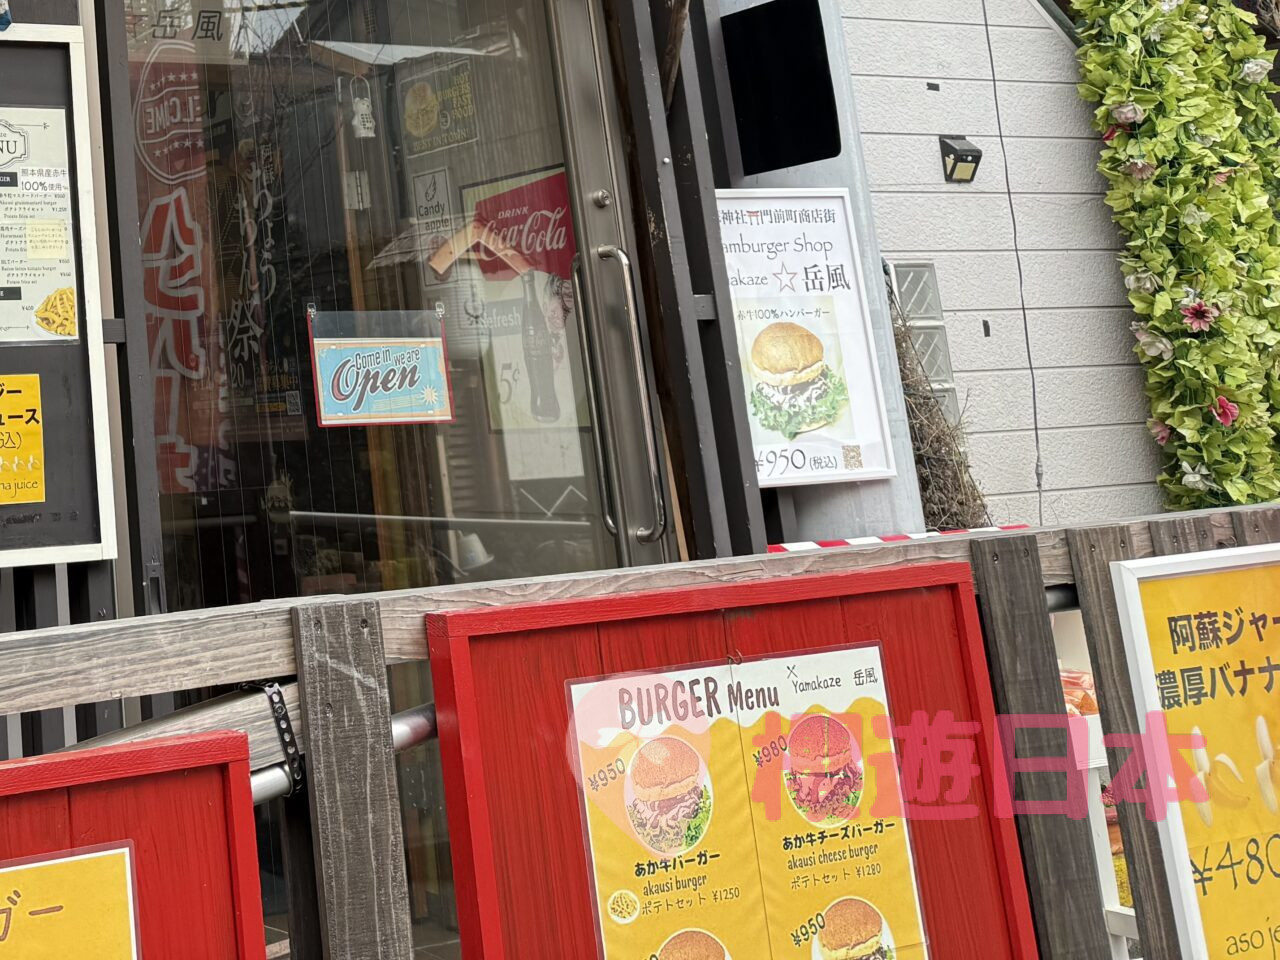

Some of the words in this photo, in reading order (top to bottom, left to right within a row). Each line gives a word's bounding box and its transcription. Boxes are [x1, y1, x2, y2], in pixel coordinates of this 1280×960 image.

[417, 202, 445, 218] Candy
[498, 206, 528, 219] DRINK
[759, 208, 837, 225] 門前町商店街
[424, 216, 450, 232] apple
[723, 233, 789, 260] amburger
[793, 232, 833, 260] Shop
[728, 273, 769, 287] akaze
[802, 264, 851, 292] 岳風
[737, 308, 830, 321] 赤牛100%ハンバーガー
[354, 352, 381, 370] Come
[382, 346, 391, 362] in
[393, 354, 406, 366] we
[406, 348, 420, 362] are
[331, 357, 421, 412] Open
[11, 479, 38, 498] juice
[1167, 606, 1280, 655] 阿蘇ジャ
[618, 676, 722, 731] BURGER
[728, 684, 780, 714] Menu
[792, 675, 842, 694] Yamakaze
[853, 667, 879, 687] 岳風
[752, 734, 788, 768] ¥980
[588, 757, 626, 792] ¥950
[782, 820, 896, 850] あか牛チーズバーガー
[634, 850, 721, 876] あか牛バーガー
[787, 851, 816, 871] akausi
[818, 848, 847, 866] cheese
[849, 843, 879, 862] burger
[643, 877, 673, 897] akausi
[675, 874, 708, 897] burger
[791, 868, 851, 890] ポテトセット
[856, 863, 881, 879] ¥1280
[642, 892, 707, 916] ポテトセット
[712, 887, 740, 902] ¥1250
[791, 912, 826, 947] ¥950
[1226, 929, 1265, 955] aso
